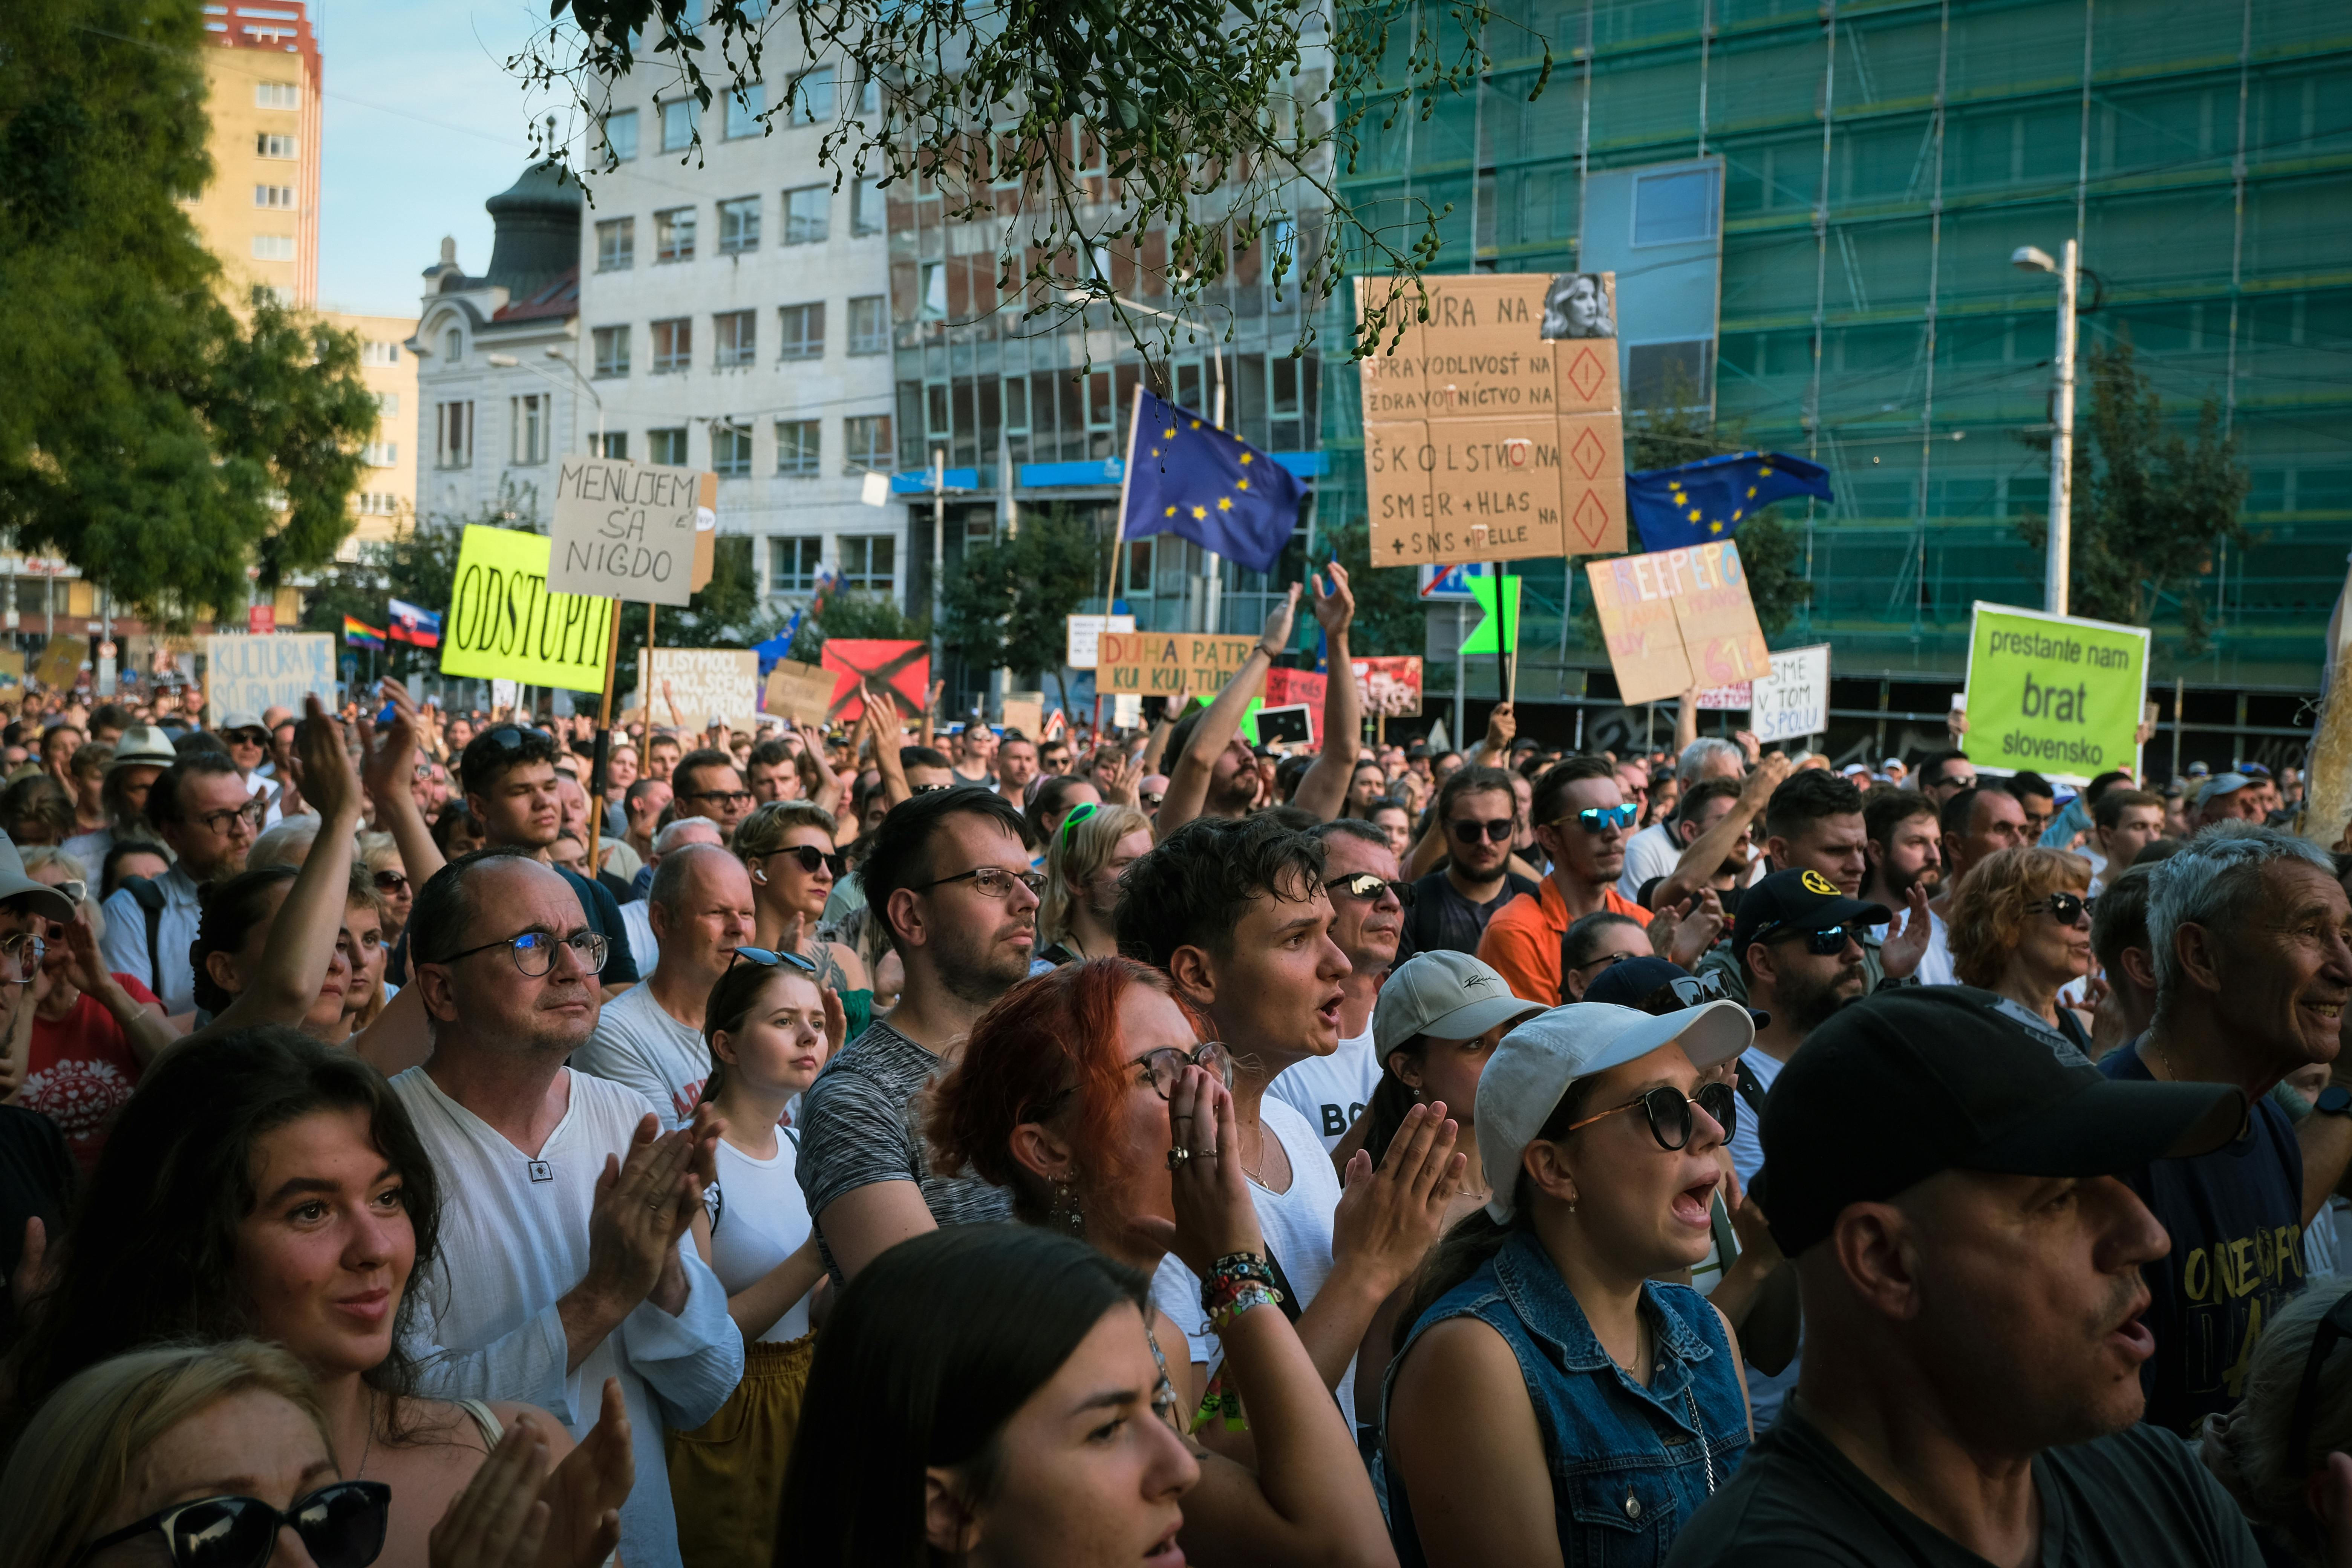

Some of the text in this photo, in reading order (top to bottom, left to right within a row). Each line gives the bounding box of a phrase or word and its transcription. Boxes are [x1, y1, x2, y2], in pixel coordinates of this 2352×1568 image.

[1497, 297, 1529, 324] NA
[1529, 356, 1551, 374] NA
[1369, 381, 1553, 411] ZDRAVOTNÍCTVO NA
[1372, 440, 1561, 473] ŠKOLSTVO NA
[557, 462, 695, 509] MENUJEM
[1382, 491, 1453, 519] SMER
[1539, 507, 1558, 524] NA
[598, 508, 646, 543] SA
[1411, 532, 1455, 554] SNS
[566, 539, 672, 583] NIGDO
[1105, 635, 1178, 664] DUHA
[1192, 640, 1249, 665] PATR
[1989, 630, 2129, 671] prestante nam
[1113, 666, 1234, 692] KU KULTÚR
[1767, 657, 1807, 686] SME
[1758, 693, 1769, 712] V
[1777, 683, 1810, 709] TOM
[2022, 671, 2087, 724] brat
[1763, 707, 1818, 739] SPOLU
[2002, 728, 2104, 766] slovensko
